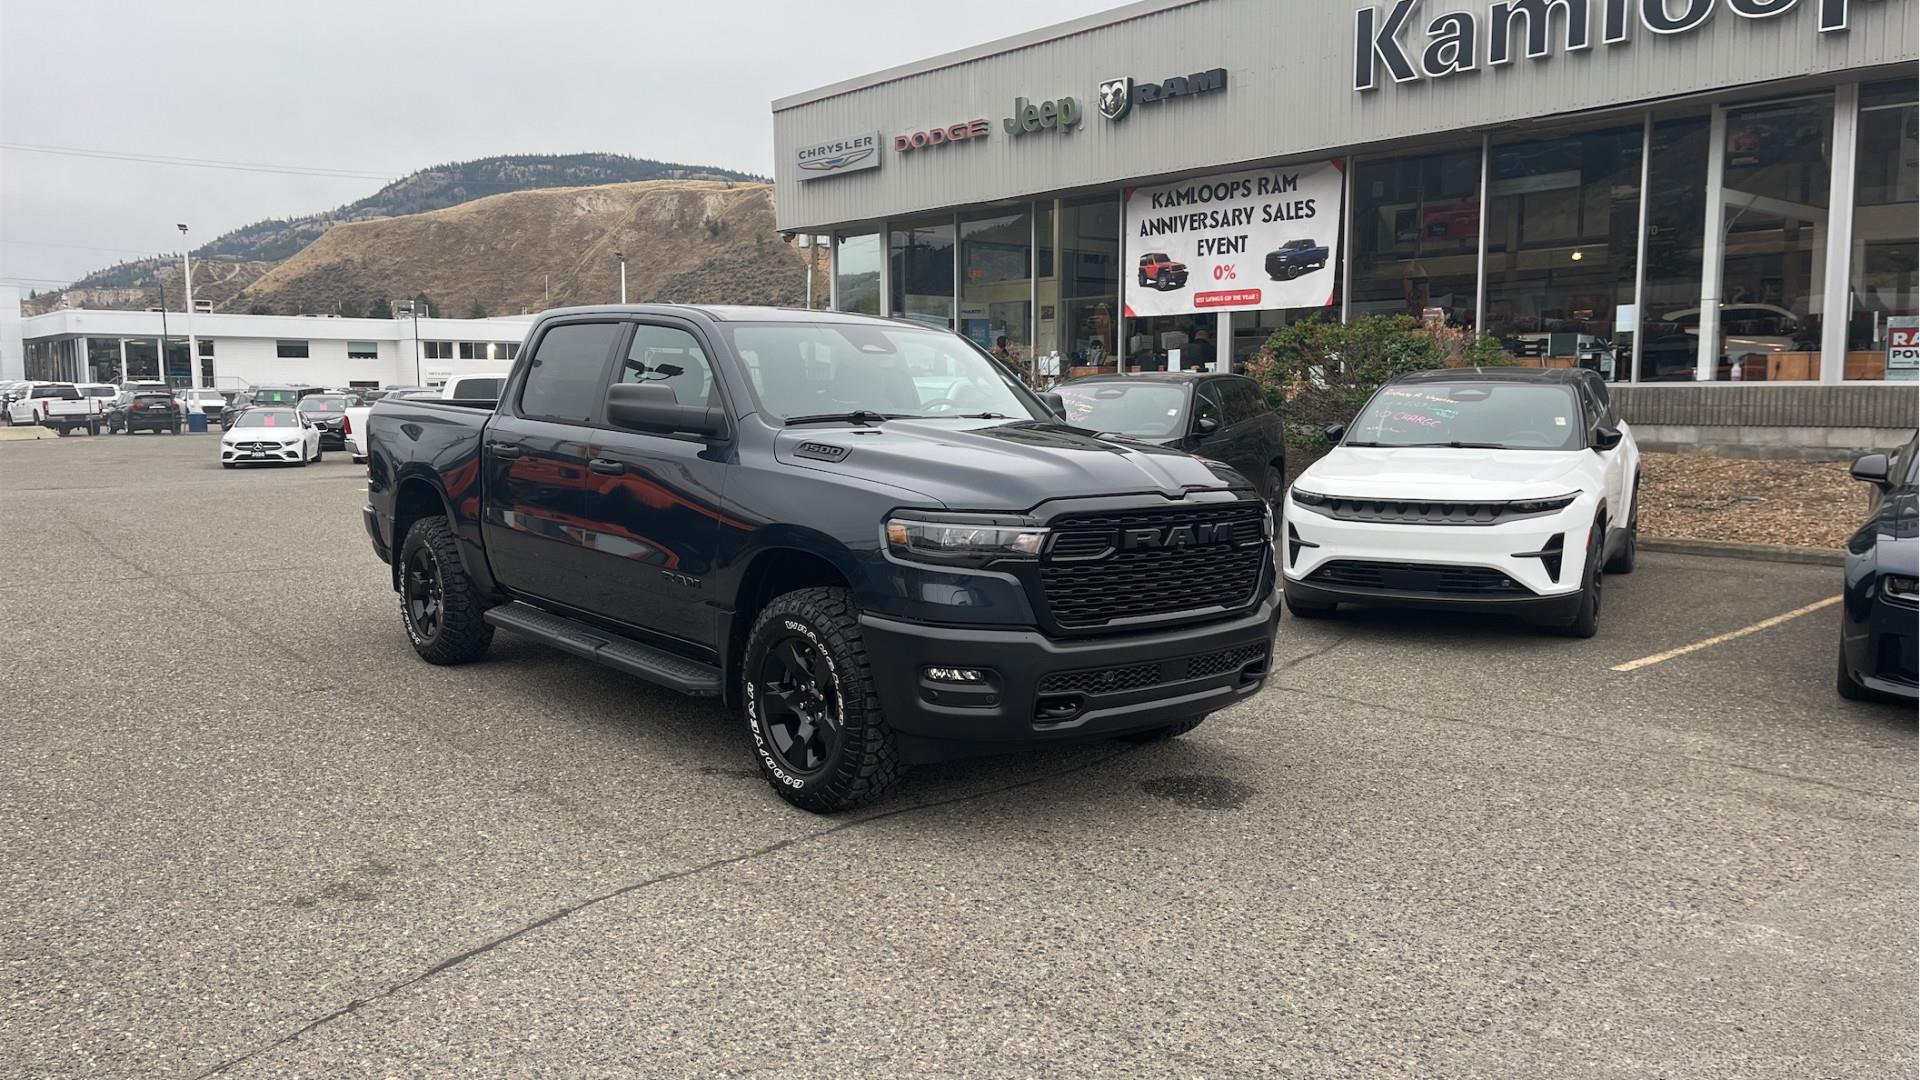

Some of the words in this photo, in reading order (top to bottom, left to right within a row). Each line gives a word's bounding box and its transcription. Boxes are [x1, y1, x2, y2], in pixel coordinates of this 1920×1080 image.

[1134, 68, 1227, 104] RAM
[1003, 96, 1082, 135] Jeep
[798, 136, 873, 160] CHRYSLER
[895, 118, 990, 152] DODGE
[1151, 179, 1251, 209] KAMLOOPS
[1257, 173, 1299, 196] RAM
[1140, 206, 1255, 237] ANNIVERSARY
[1261, 199, 1316, 224] SALES
[1197, 235, 1248, 257] EVENT
[1213, 264, 1236, 281] 0%
[804, 443, 842, 454] 1500
[1124, 522, 1234, 550] RAM
[747, 681, 804, 789] GOODYEAR
